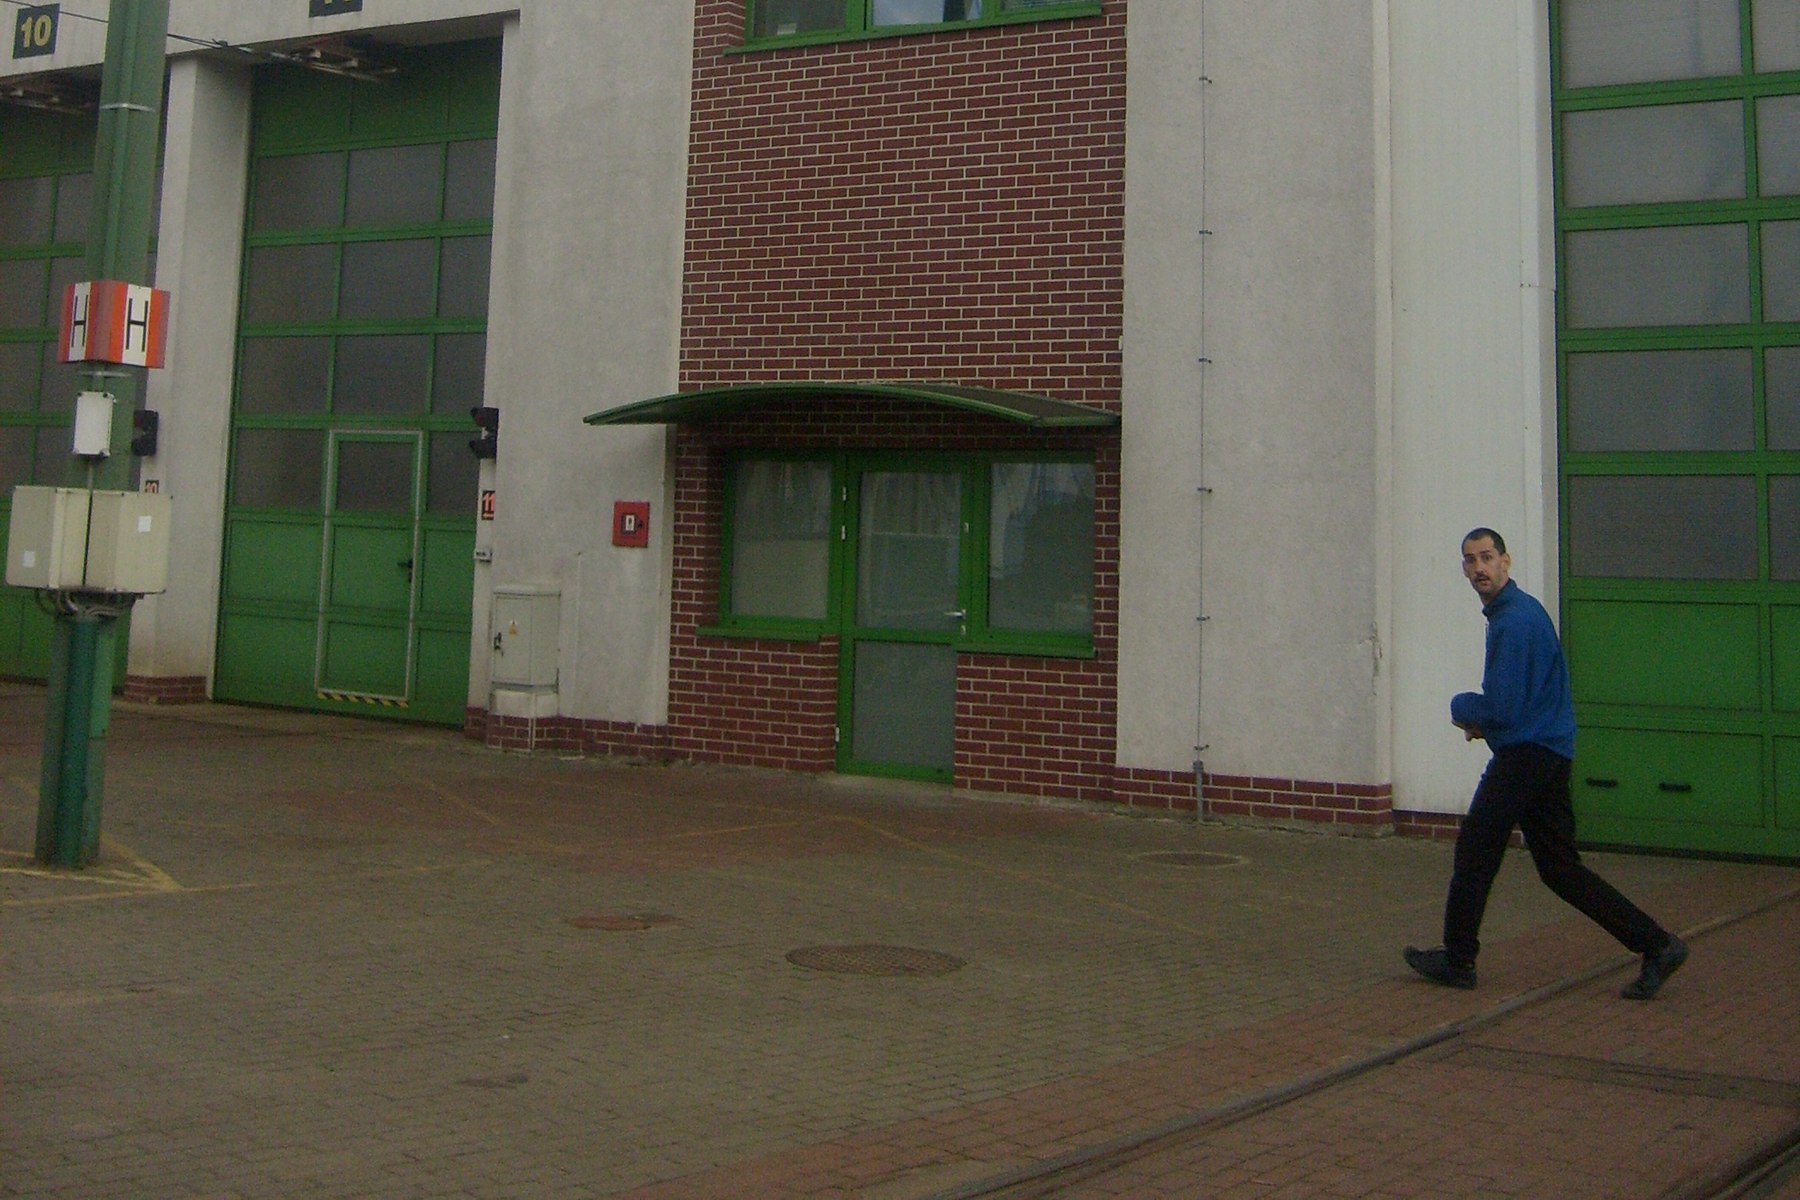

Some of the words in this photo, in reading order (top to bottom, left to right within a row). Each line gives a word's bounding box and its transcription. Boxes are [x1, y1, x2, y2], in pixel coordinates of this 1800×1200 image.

[21, 14, 52, 48] 10
[71, 294, 89, 348] H
[125, 297, 149, 352] H
[483, 492, 497, 512] 11
